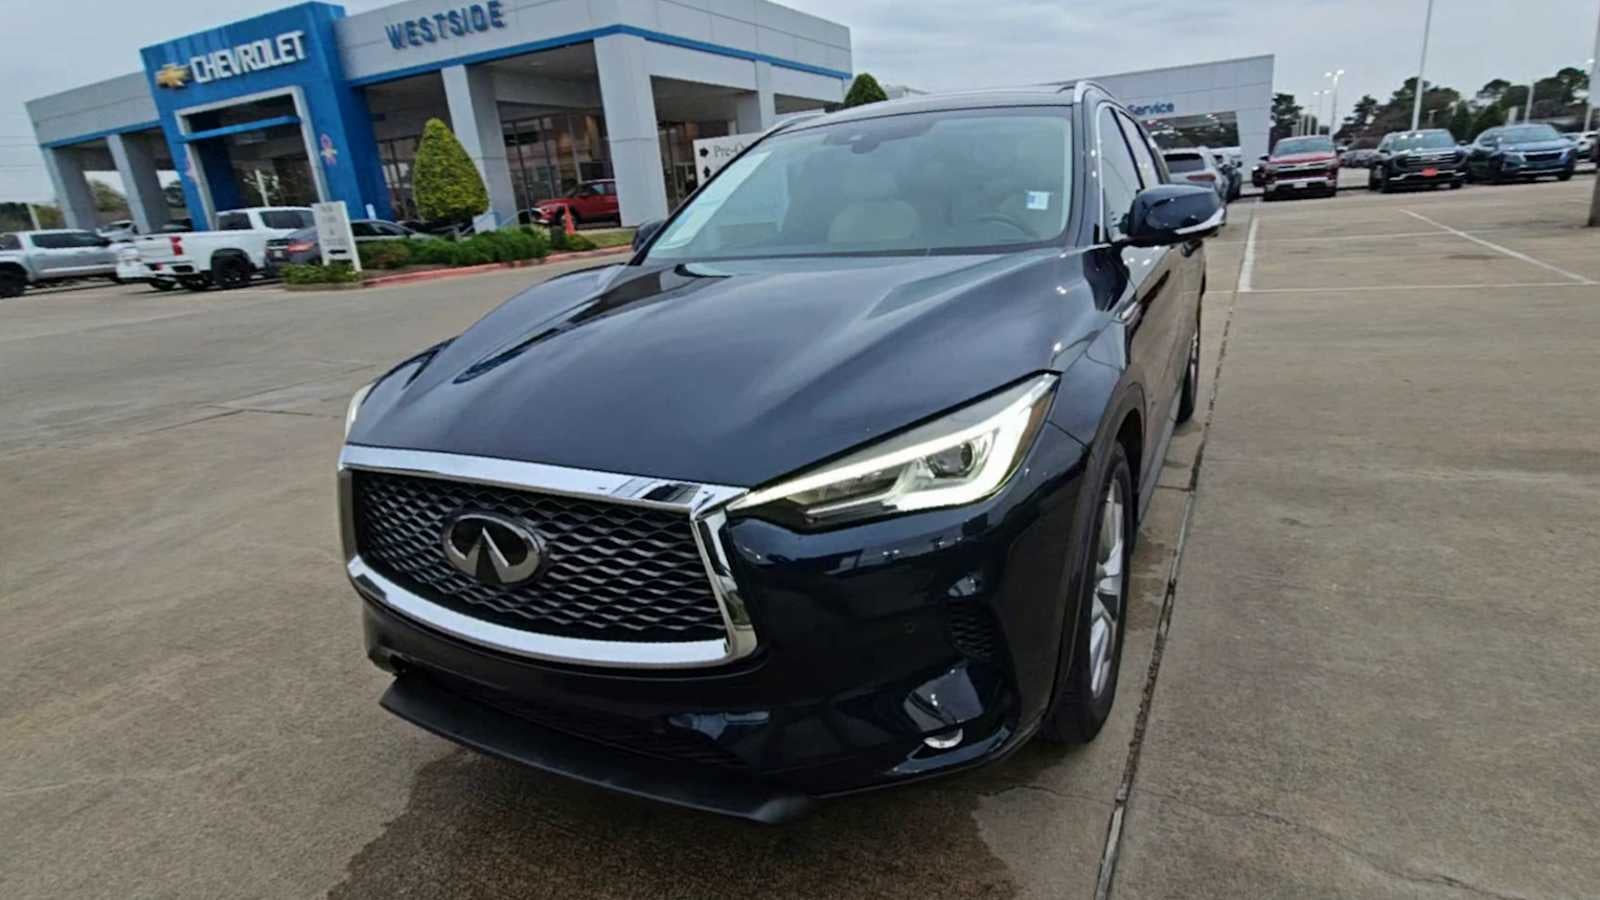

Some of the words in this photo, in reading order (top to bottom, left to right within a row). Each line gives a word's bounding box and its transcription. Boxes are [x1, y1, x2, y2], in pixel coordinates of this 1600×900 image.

[384, 0, 506, 50] WESTSIDE
[189, 29, 306, 84] CHEVROLET
[1127, 102, 1175, 115] Service
